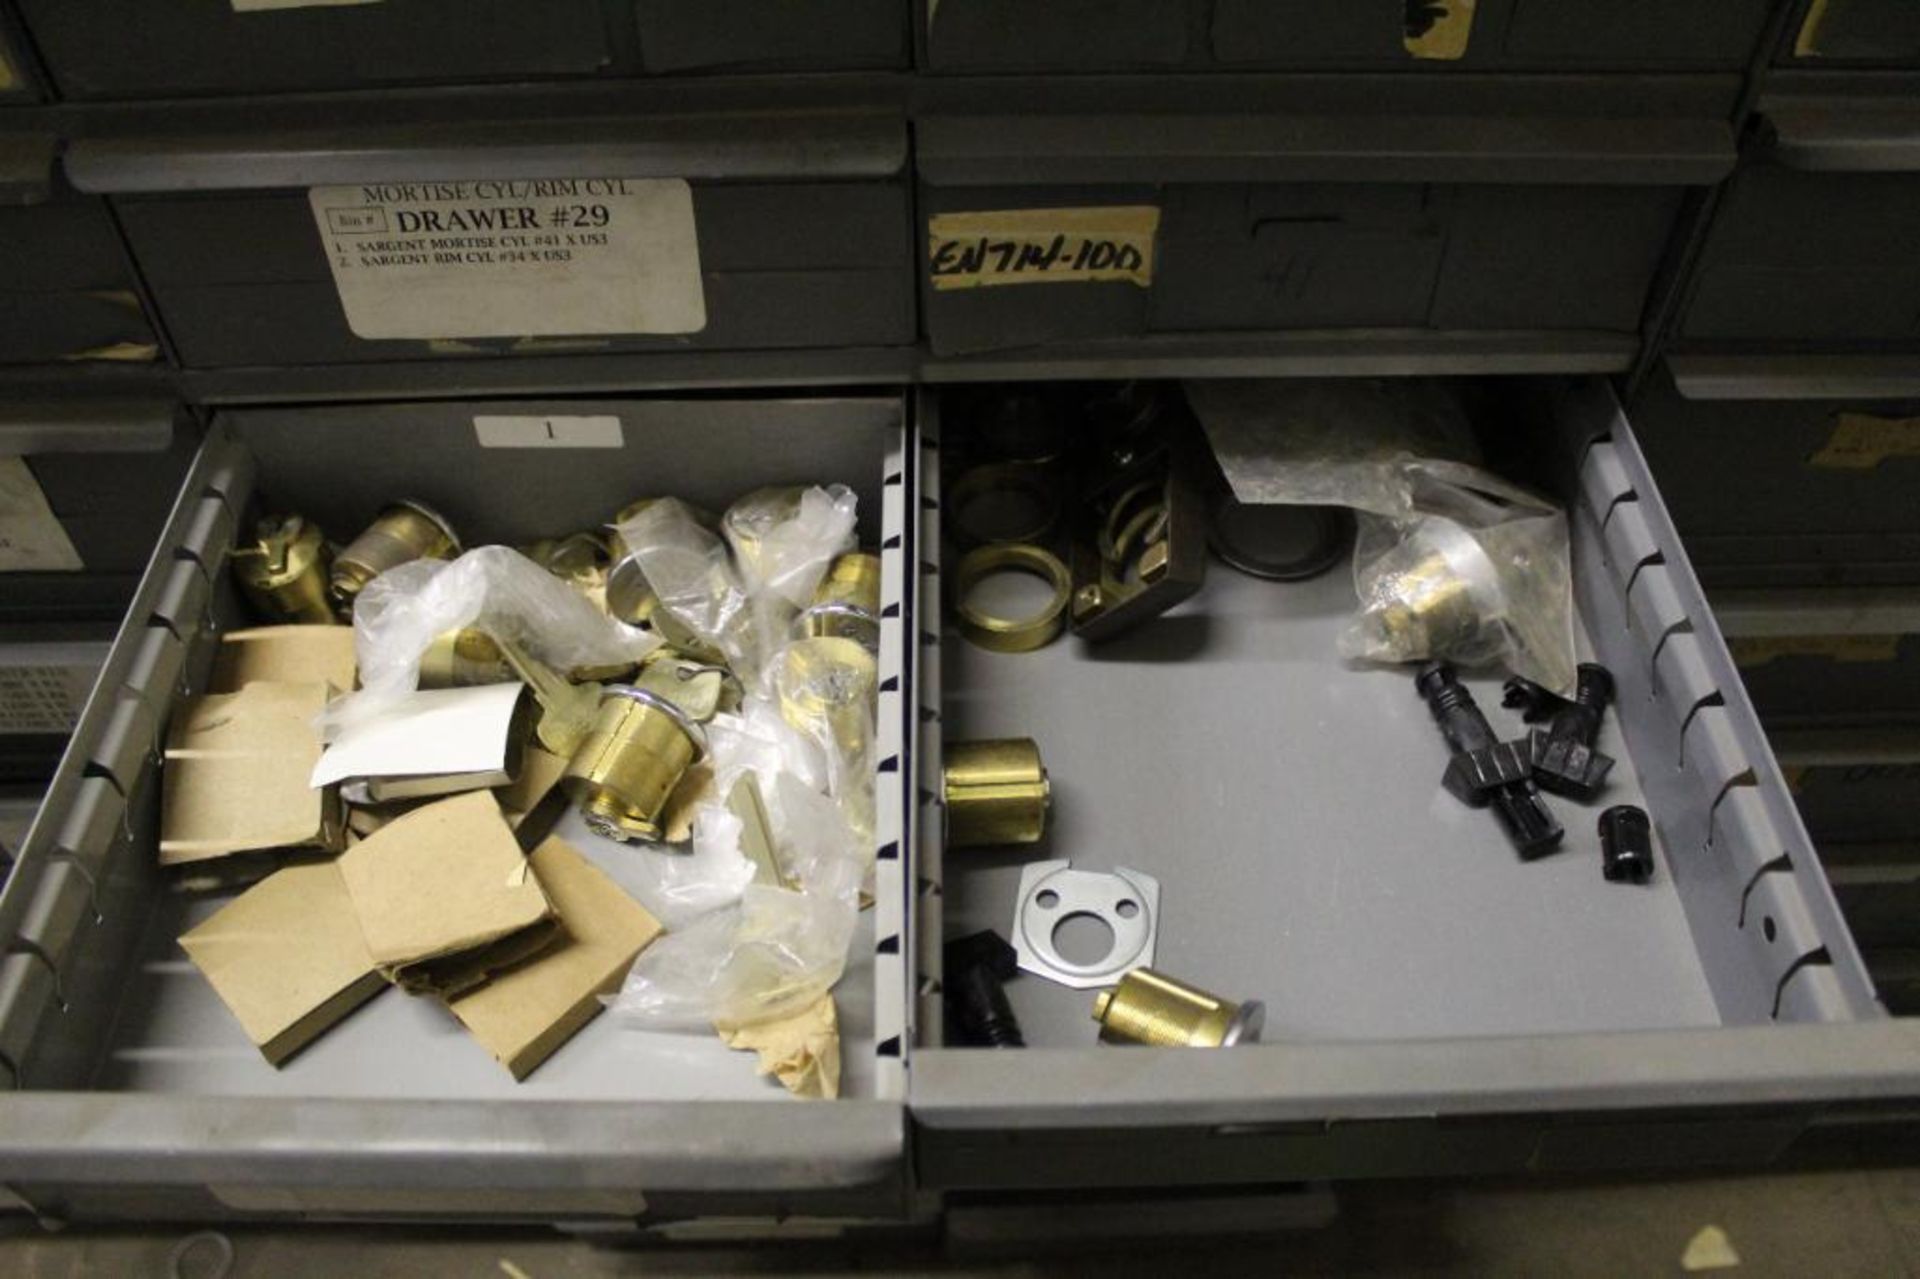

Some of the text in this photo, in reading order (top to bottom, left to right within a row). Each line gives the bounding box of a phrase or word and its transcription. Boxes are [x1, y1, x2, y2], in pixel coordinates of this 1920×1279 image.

[363, 178, 634, 203] MORTISE CYL/RIM CYL
[396, 204, 610, 233] DRAWER #29
[335, 242, 348, 254] 1.
[356, 239, 427, 253] SARGENT
[430, 236, 496, 250] MORTISE
[500, 235, 531, 248] CYL
[535, 233, 560, 247] #41
[566, 233, 577, 245] X
[360, 253, 431, 267] SARGENT
[434, 252, 462, 265] RIM
[466, 251, 496, 264] CYL
[531, 249, 541, 262] X
